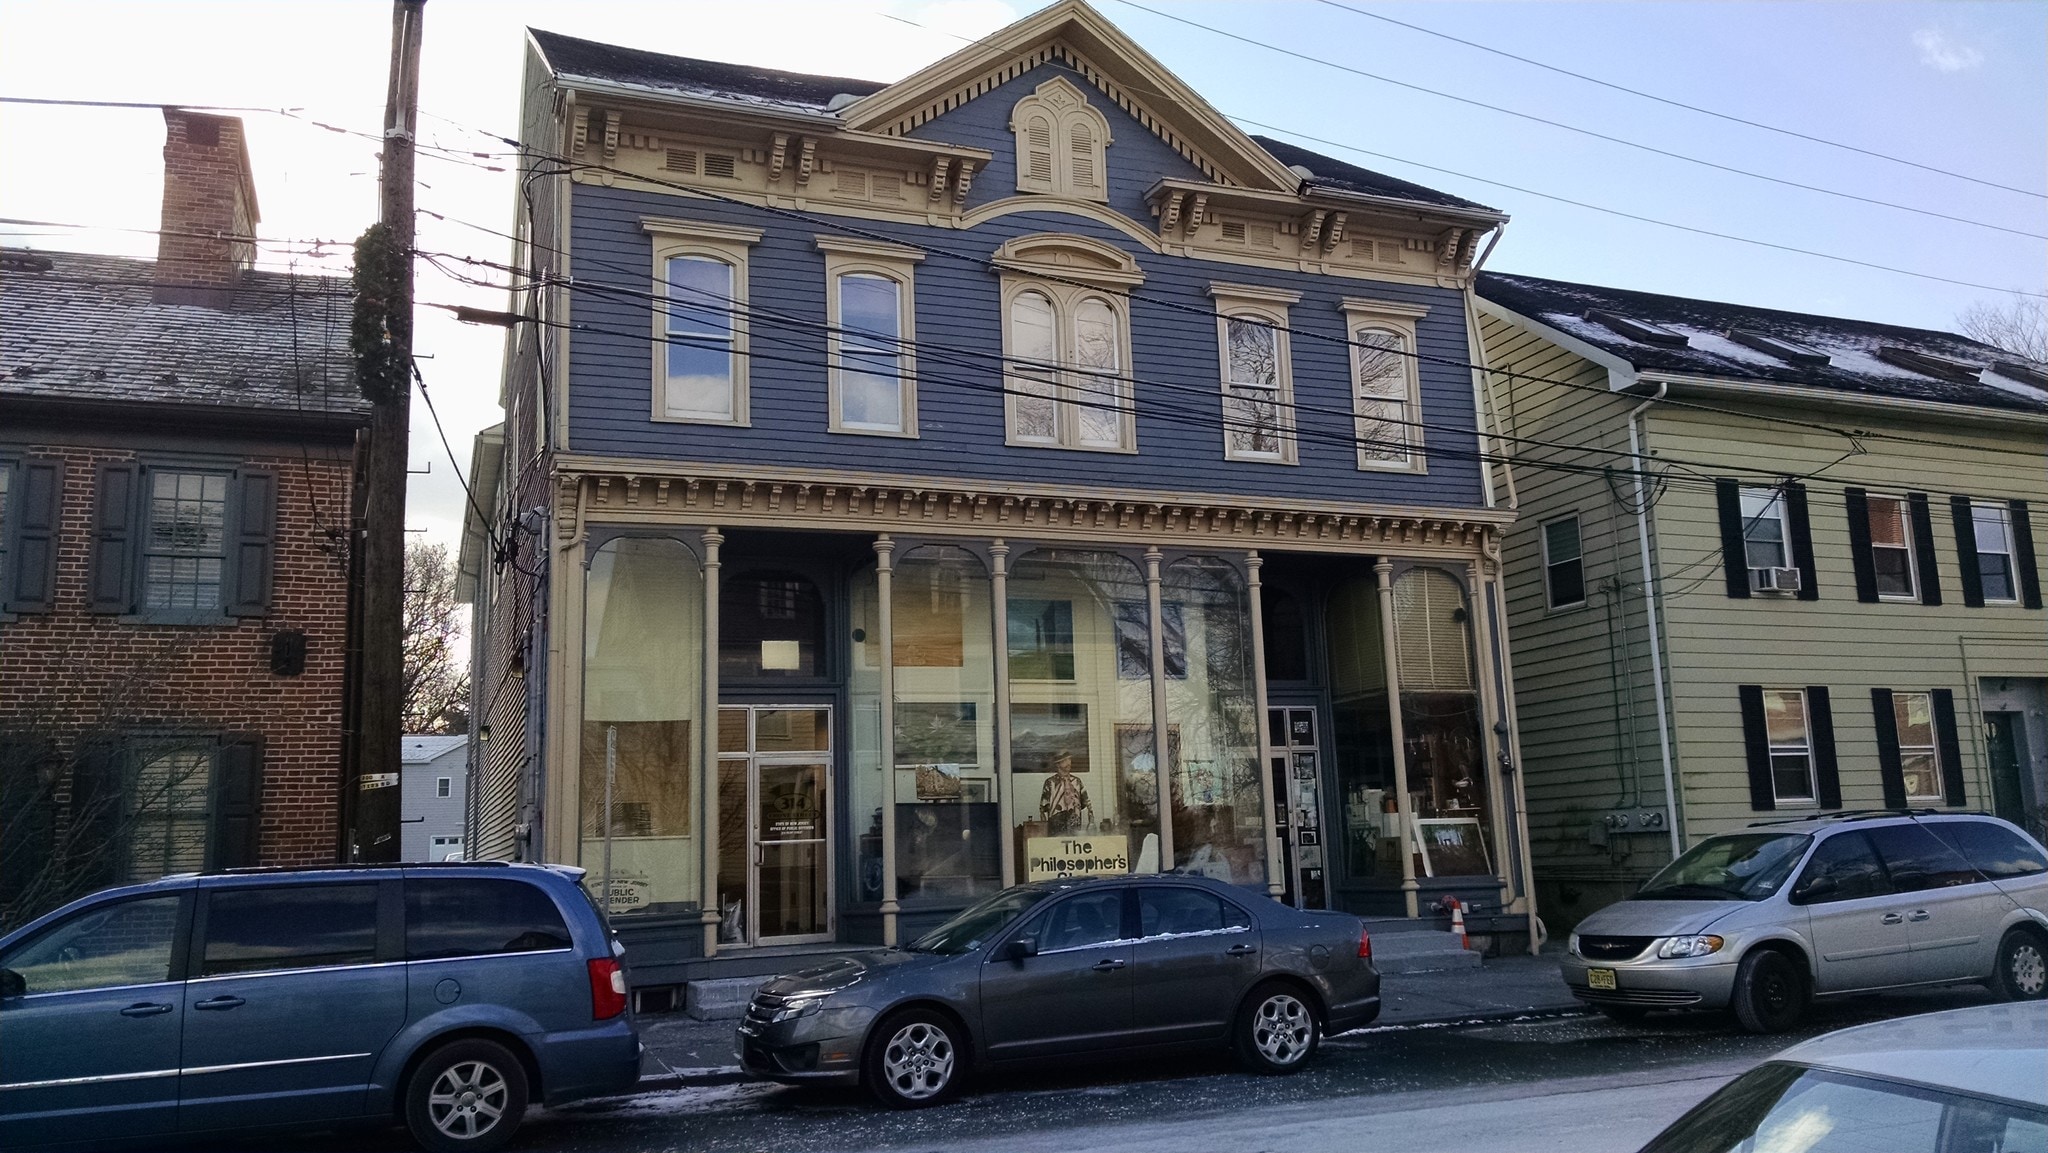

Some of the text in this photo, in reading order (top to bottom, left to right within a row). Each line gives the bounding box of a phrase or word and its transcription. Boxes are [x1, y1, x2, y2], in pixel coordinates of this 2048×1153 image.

[781, 797, 805, 810] 314
[1061, 840, 1092, 854] The
[1031, 854, 1127, 873] Philosopher's
[606, 888, 634, 896] UBLIC
[595, 896, 640, 904] DEENDER
